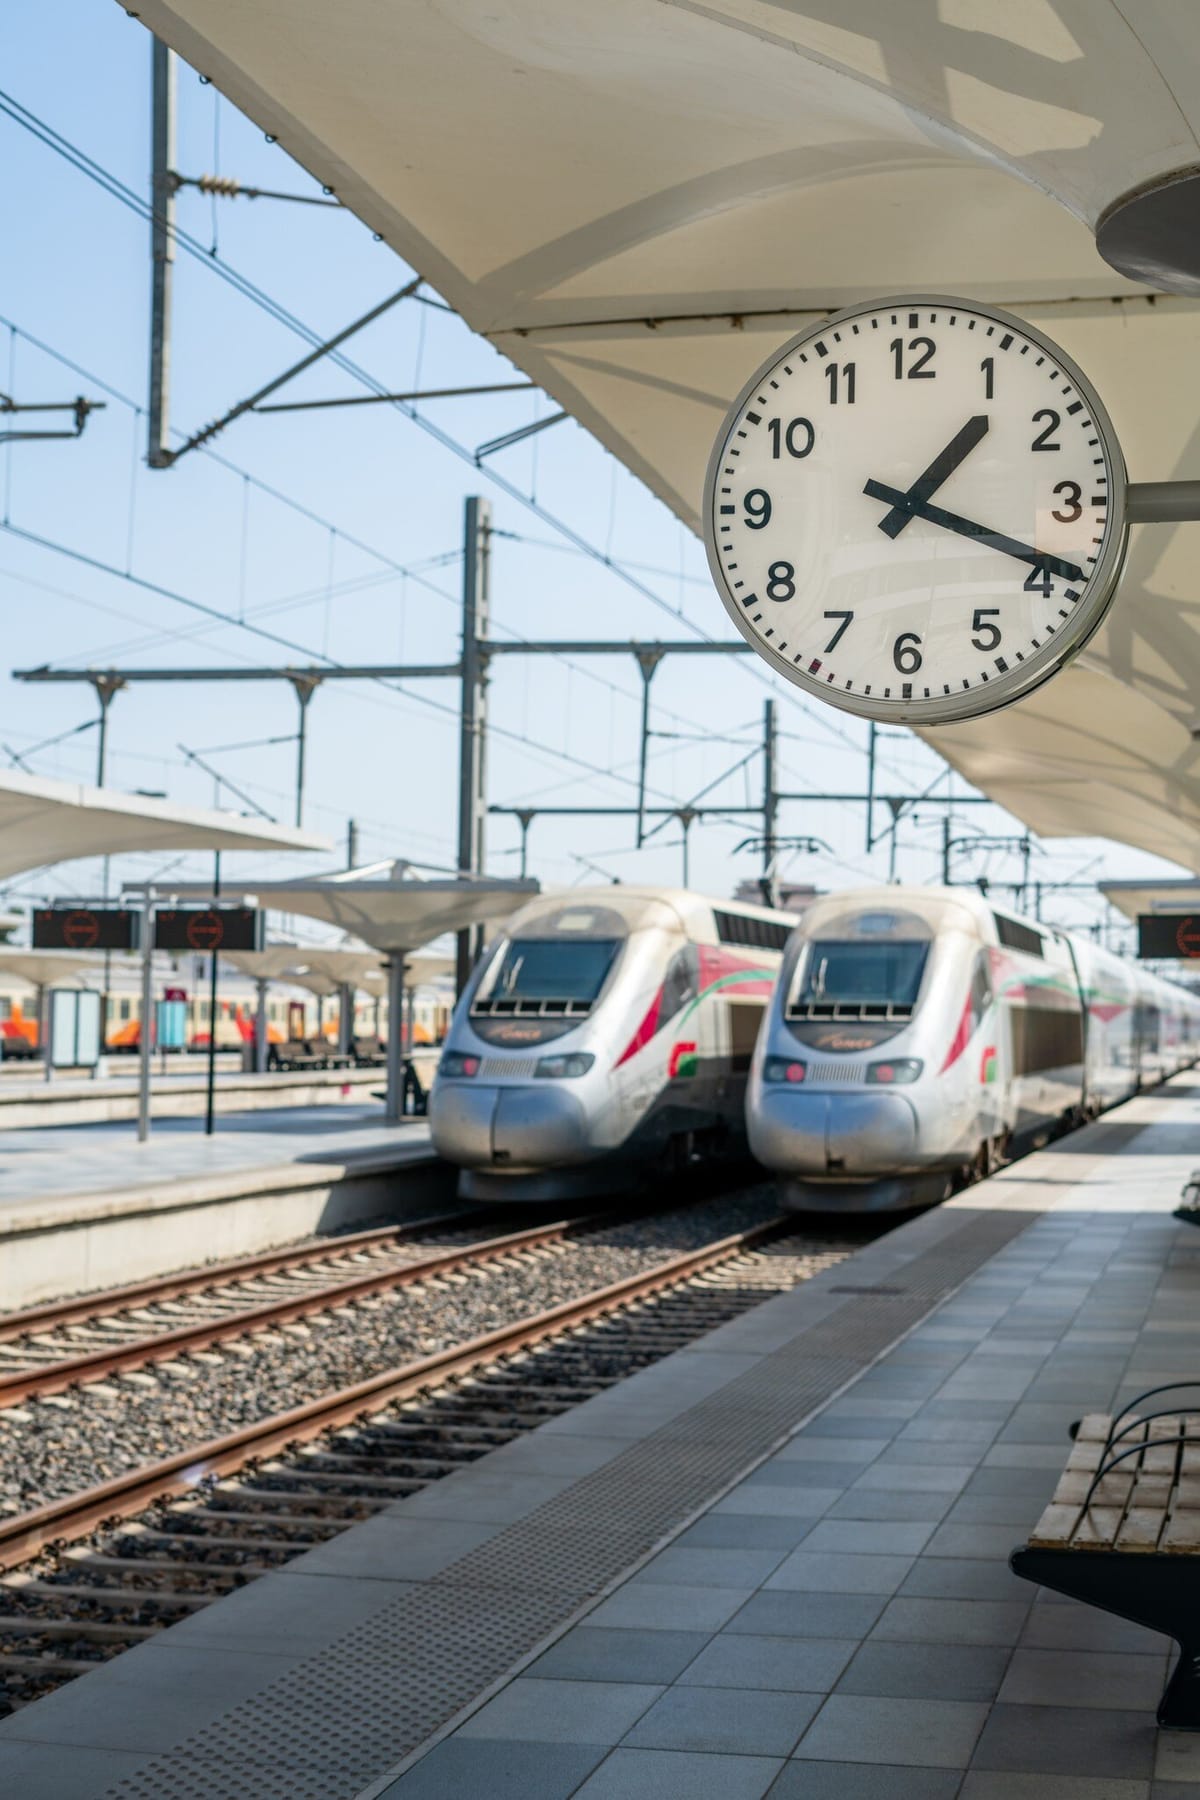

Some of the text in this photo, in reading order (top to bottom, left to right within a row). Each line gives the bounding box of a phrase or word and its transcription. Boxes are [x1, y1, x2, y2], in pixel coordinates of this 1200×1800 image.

[890, 337, 937, 380] 12
[980, 357, 994, 400] 1
[825, 362, 856, 405] 11
[767, 417, 815, 460] 10
[1031, 408, 1061, 452] 2
[743, 488, 772, 530] 9
[1051, 480, 1083, 523] 3
[766, 560, 796, 603] 8
[1023, 559, 1055, 599] 4
[823, 610, 854, 654] 7
[971, 608, 1002, 652] 5
[893, 632, 923, 675] 6
